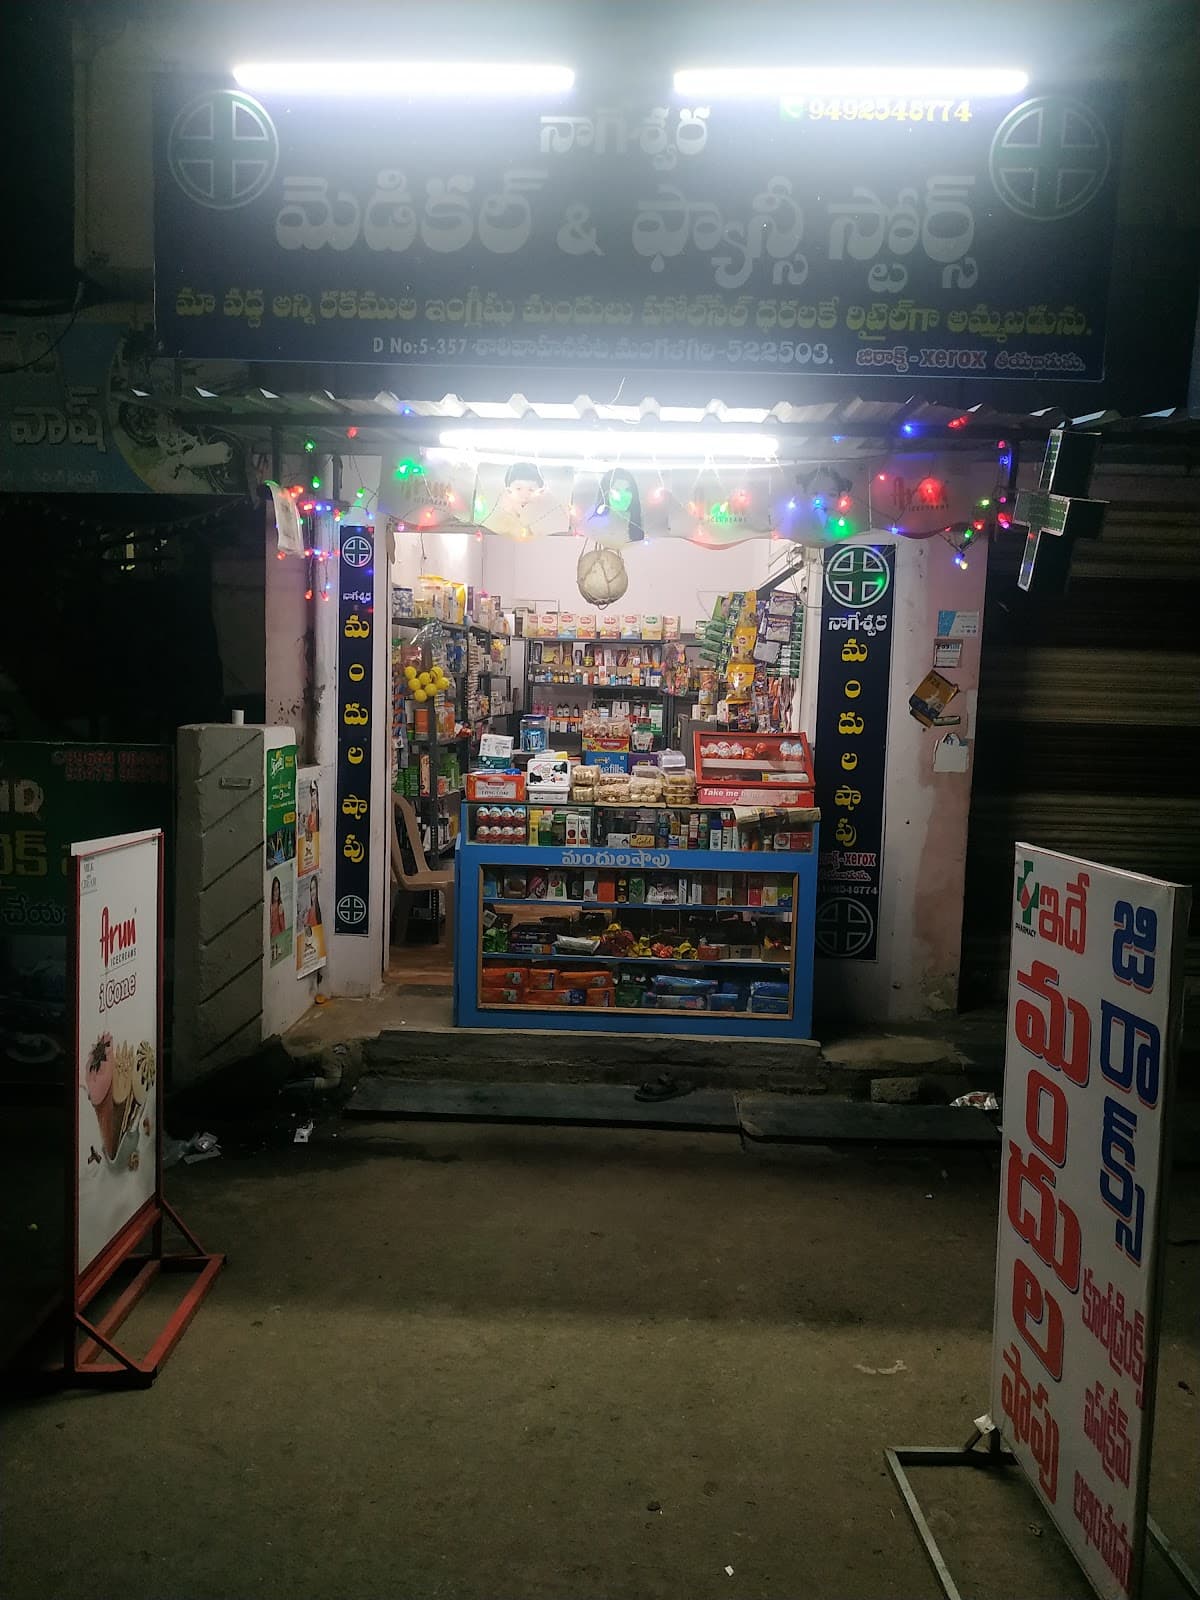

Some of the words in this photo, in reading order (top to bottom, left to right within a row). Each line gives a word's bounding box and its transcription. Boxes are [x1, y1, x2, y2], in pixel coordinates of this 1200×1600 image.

[556, 201, 605, 256] &
[176, 287, 216, 317] మా
[224, 287, 264, 328] వద్ద
[273, 293, 316, 326] అన్ని
[373, 337, 383, 352] D
[828, 611, 888, 637] నాగేశ్వర
[703, 788, 725, 797] Take
[726, 790, 739, 798] me
[1015, 921, 1037, 938] PHARMACY
[1038, 872, 1091, 955] ఇదే
[99, 906, 136, 969] Arun
[110, 947, 137, 968] ICECREAMS
[98, 974, 136, 1014] iCone
